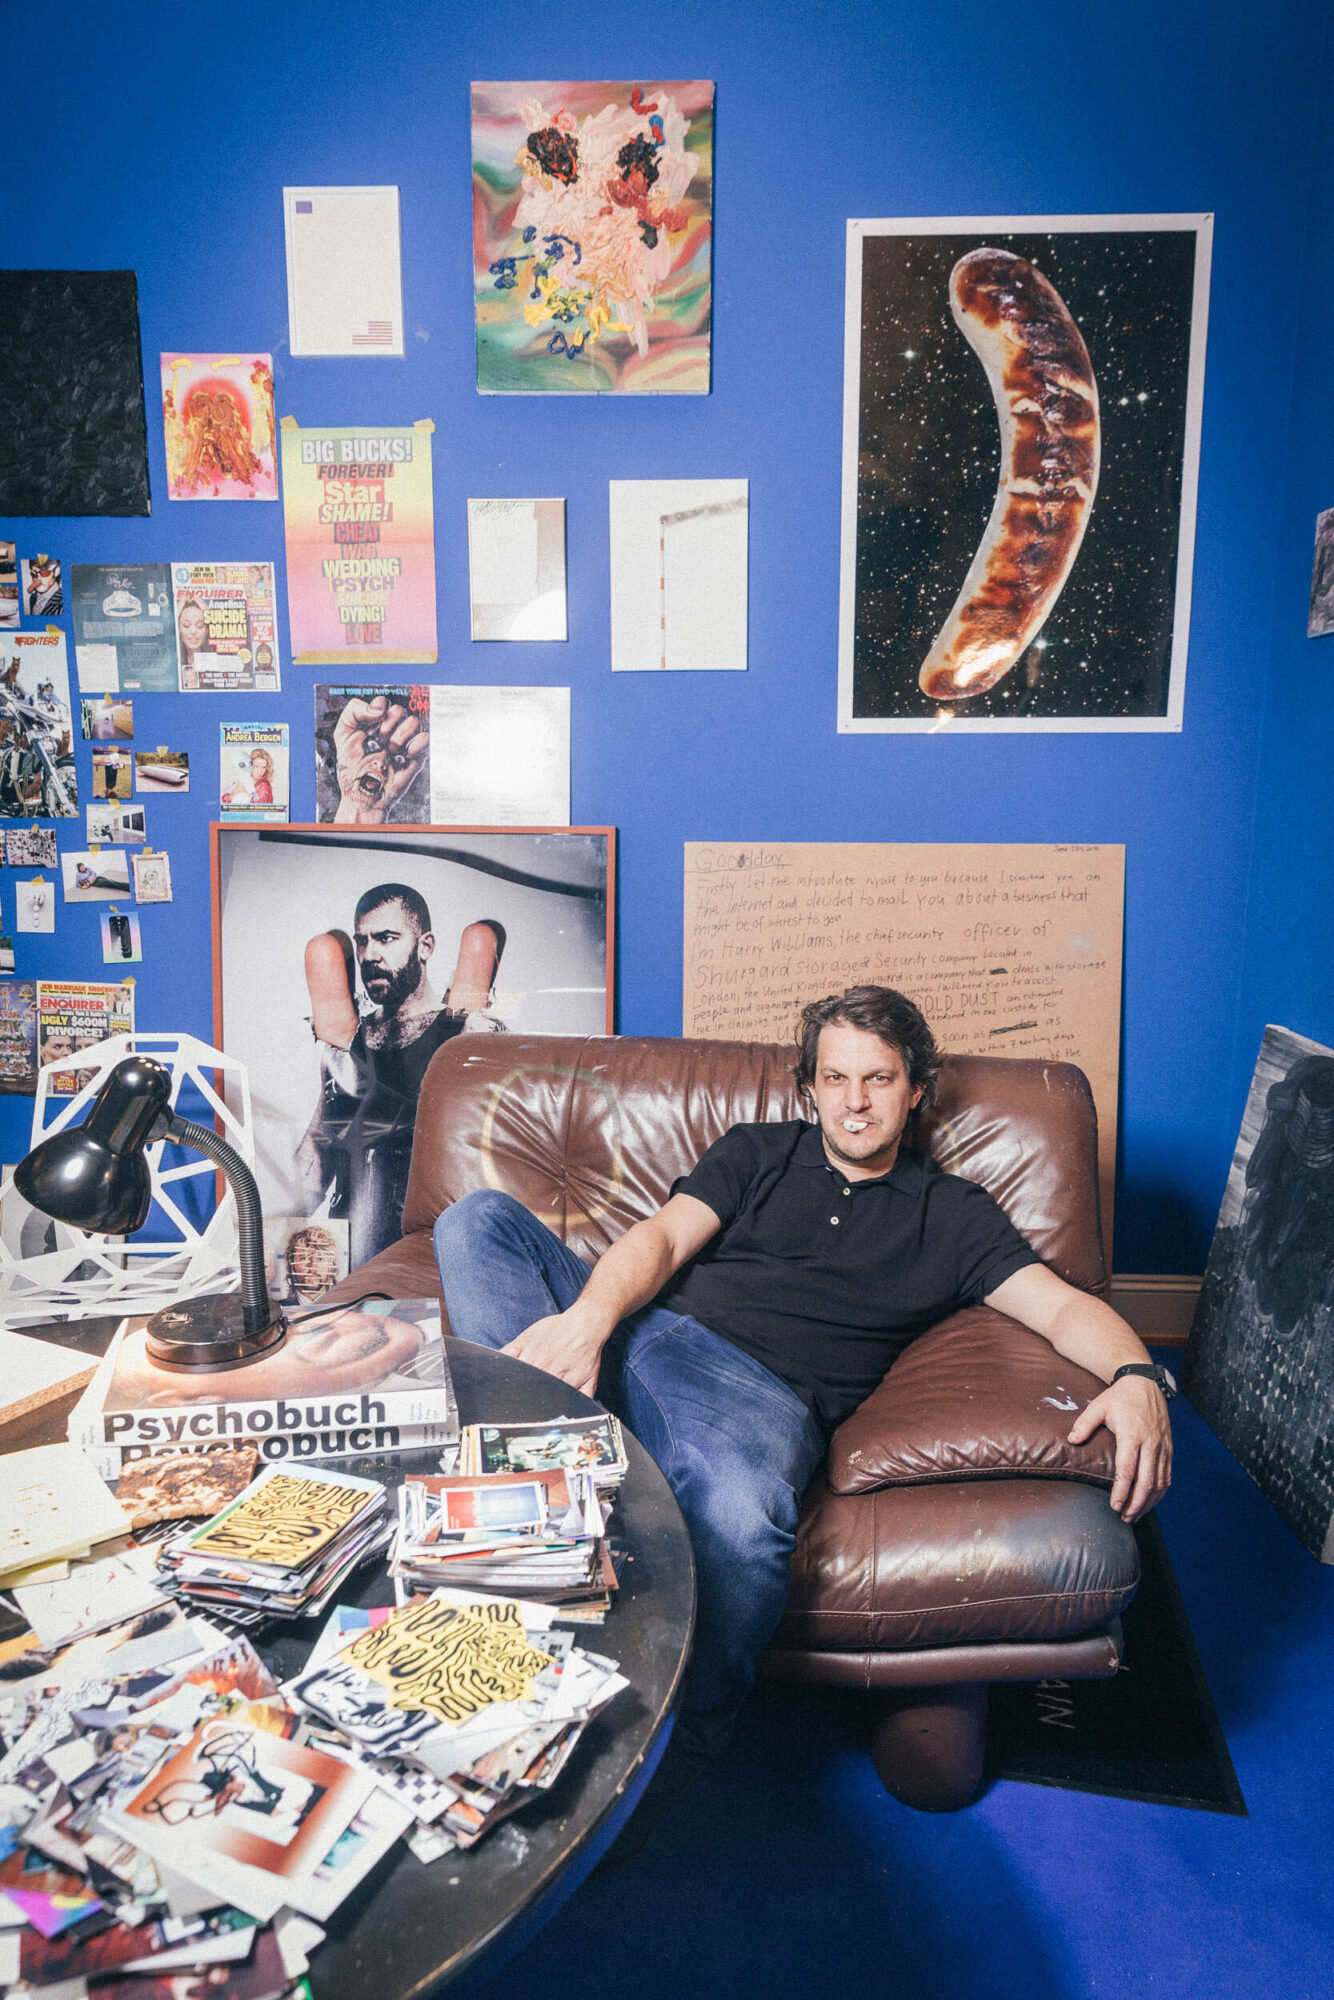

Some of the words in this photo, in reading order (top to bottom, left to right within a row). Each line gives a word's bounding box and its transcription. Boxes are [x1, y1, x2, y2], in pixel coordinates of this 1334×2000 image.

[303, 440, 335, 463] BIG
[340, 438, 412, 462] BUCKS!
[318, 464, 393, 479] FOREVER!
[325, 482, 382, 504] Star
[321, 503, 389, 522] SHAME!
[335, 522, 380, 542] CHEAT
[323, 559, 400, 576] WEDDING
[332, 577, 395, 592] PSYCH
[177, 590, 243, 599] ENQUIRER
[208, 600, 246, 610] Angelina:
[203, 609, 246, 624] SUICIDE
[340, 606, 385, 623] DYING!
[209, 624, 247, 638] DRAMA!
[346, 624, 382, 643] LOVE
[226, 732, 252, 741] ANDREA
[254, 732, 281, 742] BERGEN
[771, 877, 791, 887] me
[905, 871, 915, 885] to
[920, 874, 938, 887] you
[944, 870, 988, 884] because
[777, 896, 797, 911] and
[806, 889, 854, 908] decided
[860, 890, 874, 906] to
[956, 889, 998, 905] about
[1002, 892, 1009, 902] a
[1061, 888, 1089, 902] that
[695, 918, 730, 937] might
[736, 917, 751, 932] be
[753, 915, 763, 933] of
[806, 912, 819, 925] to
[722, 939, 765, 960] Harry
[840, 927, 861, 946] the
[866, 928, 894, 944] chief
[896, 928, 944, 942] security
[964, 922, 1020, 942] officer
[1032, 920, 1053, 937] of
[695, 957, 792, 989] Shurgard
[692, 988, 740, 1010] London,
[744, 984, 759, 998] the
[762, 982, 793, 997] United
[851, 971, 903, 986] Shurgard
[968, 967, 985, 977] that
[1012, 963, 1040, 974] deals
[40, 998, 104, 1011] ENQUIRER
[733, 1003, 752, 1015] and
[772, 1011, 789, 1022] and
[911, 993, 953, 1013] GOLD
[960, 991, 999, 1008] DUST
[1003, 1002, 1038, 1014] custody
[1043, 999, 1057, 1013] for
[41, 1015, 68, 1025] UGLY
[71, 1016, 107, 1028] $600M
[942, 1033, 969, 1042] soon
[1046, 1017, 1061, 1026] as
[47, 1026, 103, 1038] DIVORCE!
[104, 1395, 386, 1442] Psychobuch
[120, 1425, 400, 1465] Pobuch
